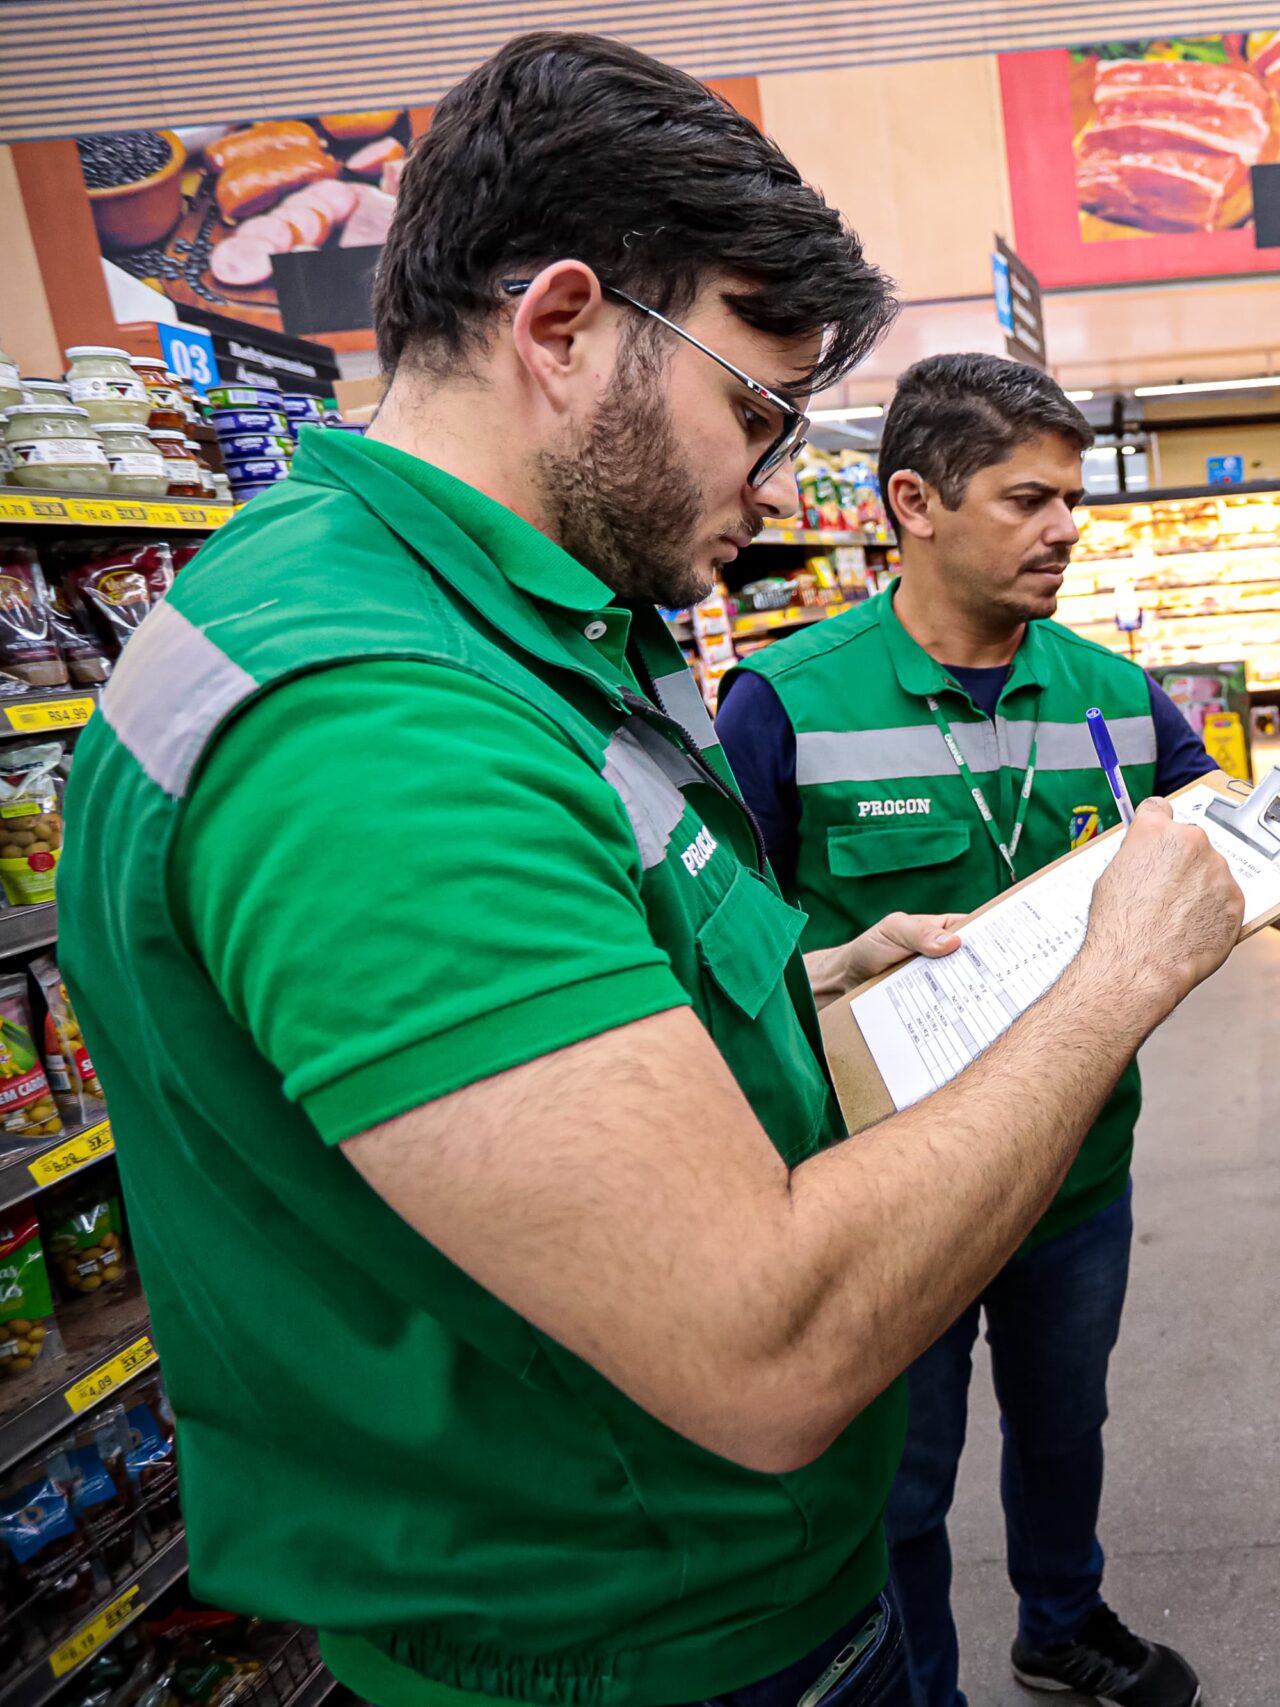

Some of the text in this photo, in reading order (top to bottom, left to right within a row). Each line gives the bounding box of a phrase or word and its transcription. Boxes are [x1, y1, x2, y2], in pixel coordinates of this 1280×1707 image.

[169, 339, 213, 386] 03
[858, 798, 931, 818] PROCON
[88, 1374, 113, 1398] 4,09
